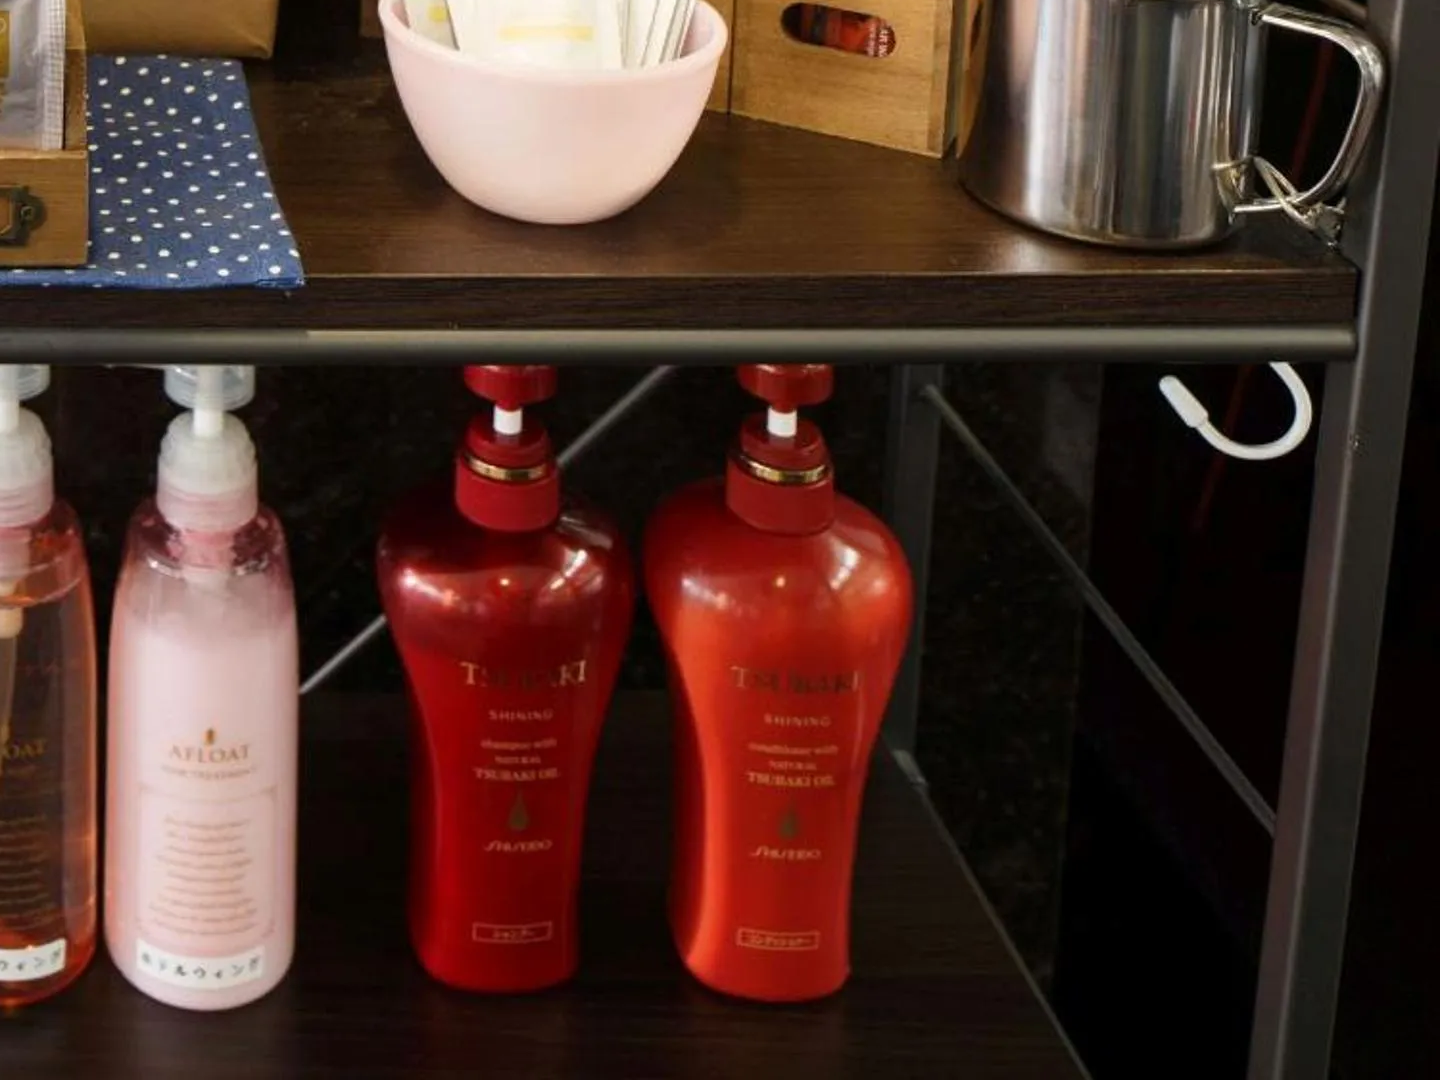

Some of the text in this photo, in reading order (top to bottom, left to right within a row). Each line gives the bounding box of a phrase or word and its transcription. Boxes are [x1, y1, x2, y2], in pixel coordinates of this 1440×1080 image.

[487, 708, 555, 723] SHINING
[763, 712, 832, 729] SHINING
[167, 742, 252, 764] AFLOAT
